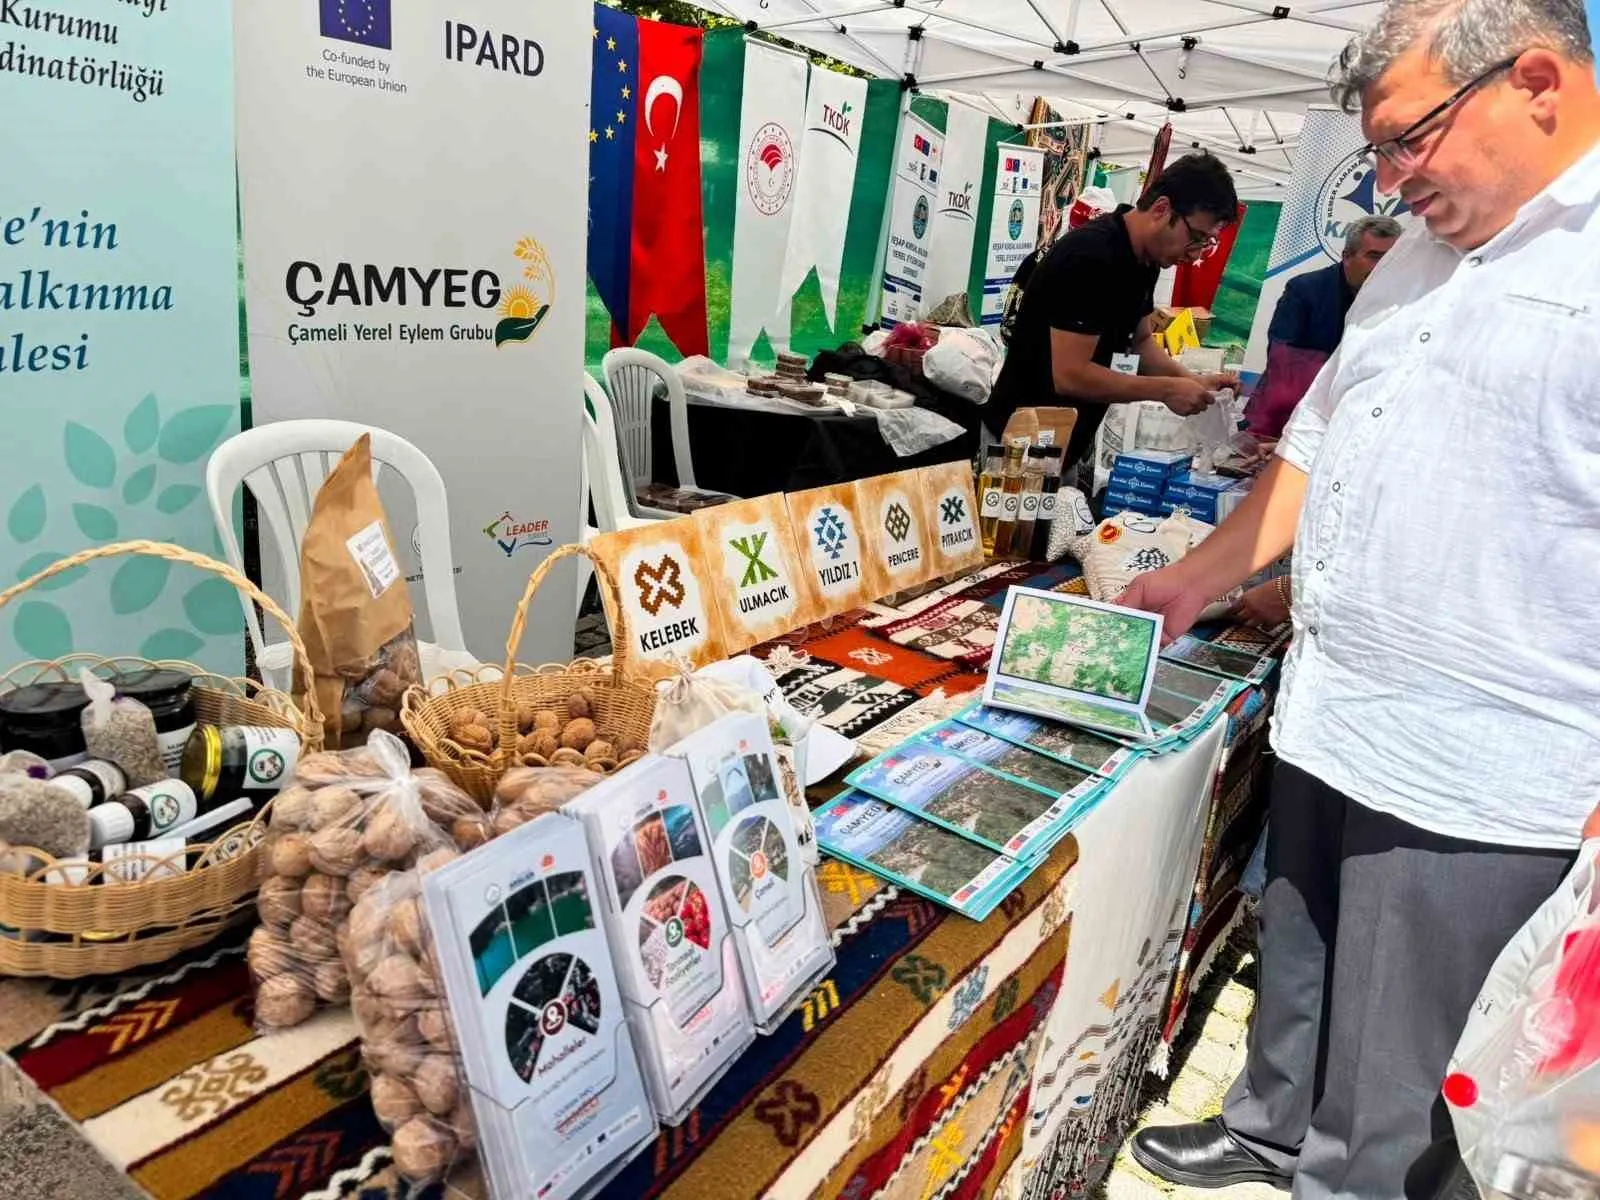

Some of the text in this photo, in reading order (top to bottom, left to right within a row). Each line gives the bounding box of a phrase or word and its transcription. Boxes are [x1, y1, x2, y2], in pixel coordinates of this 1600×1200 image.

[0, 0, 119, 45] Kurumu
[322, 48, 391, 73] Co-funded by
[445, 19, 545, 77] IPARD
[0, 41, 165, 102] dinatörlüğü
[306, 64, 408, 94] the European Union
[823, 103, 851, 137] TKDK
[947, 190, 972, 211] TKDK
[0, 205, 119, 251] e'nin
[285, 259, 502, 318] ÇAMYEG
[288, 322, 494, 346] Çameli Yerel Eylem Grubu
[505, 519, 550, 537] LEADER
[818, 559, 860, 588] YILDIZ 1
[888, 547, 920, 569] PENCERE
[739, 584, 791, 615] ULMACIK
[639, 616, 700, 653] KELEBEK
